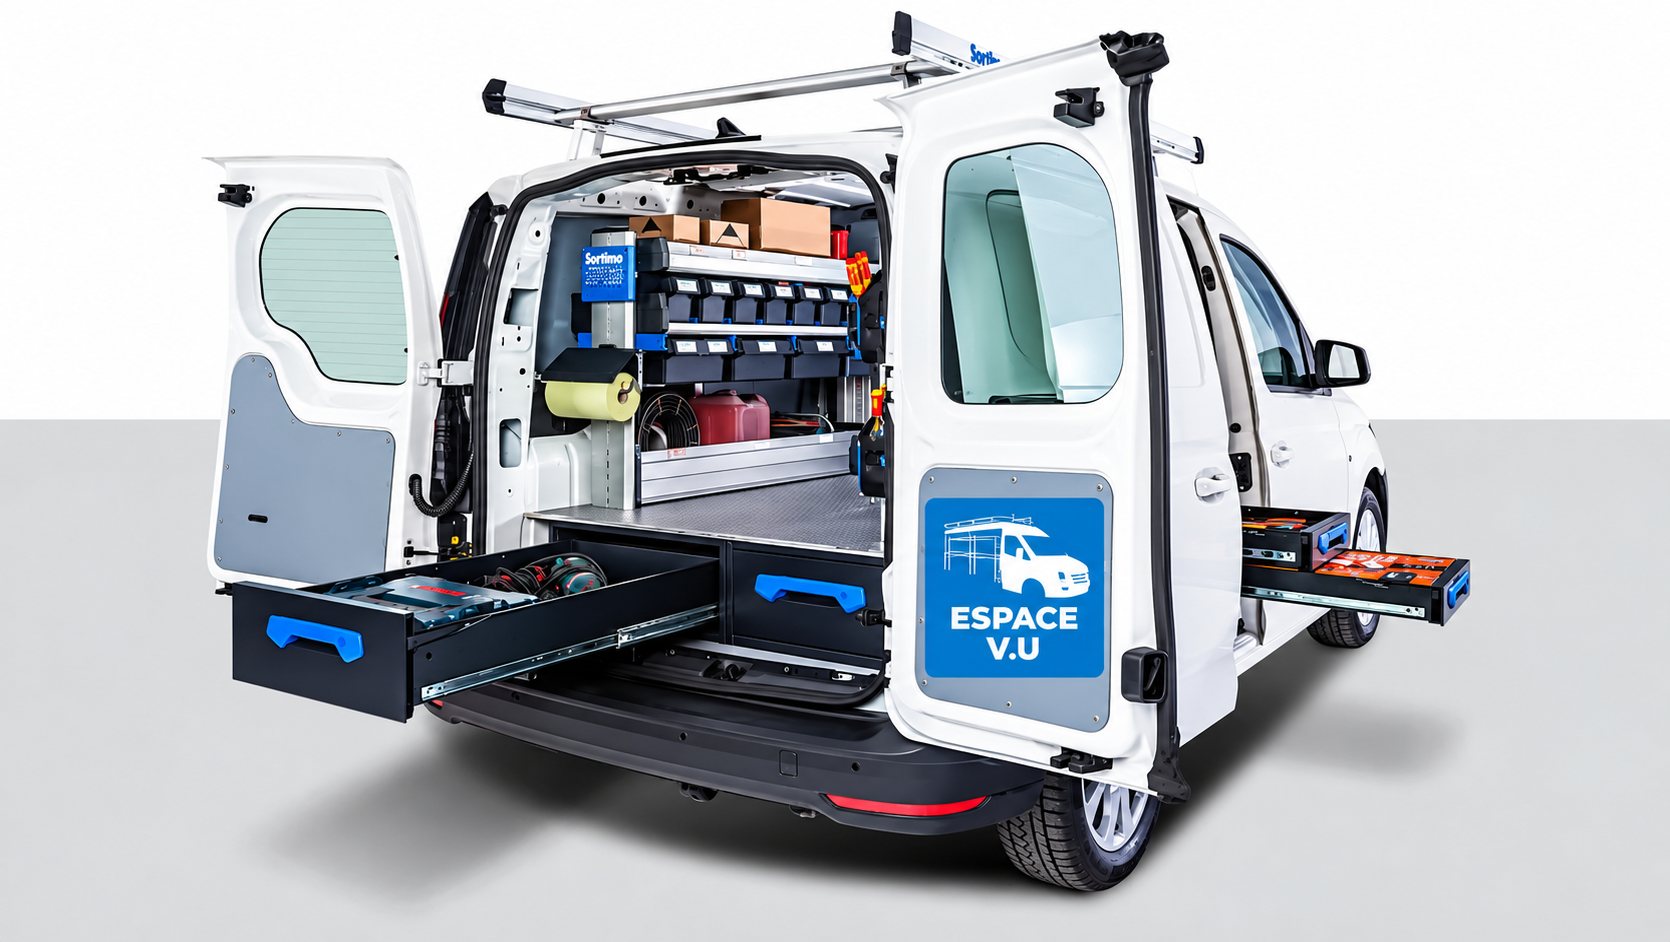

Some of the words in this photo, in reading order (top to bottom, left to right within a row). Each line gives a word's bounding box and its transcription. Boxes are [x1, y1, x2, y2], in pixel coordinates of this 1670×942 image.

[585, 252, 623, 265] Sortimo
[951, 606, 1078, 630] ESPACE
[986, 637, 1039, 660] V.U
